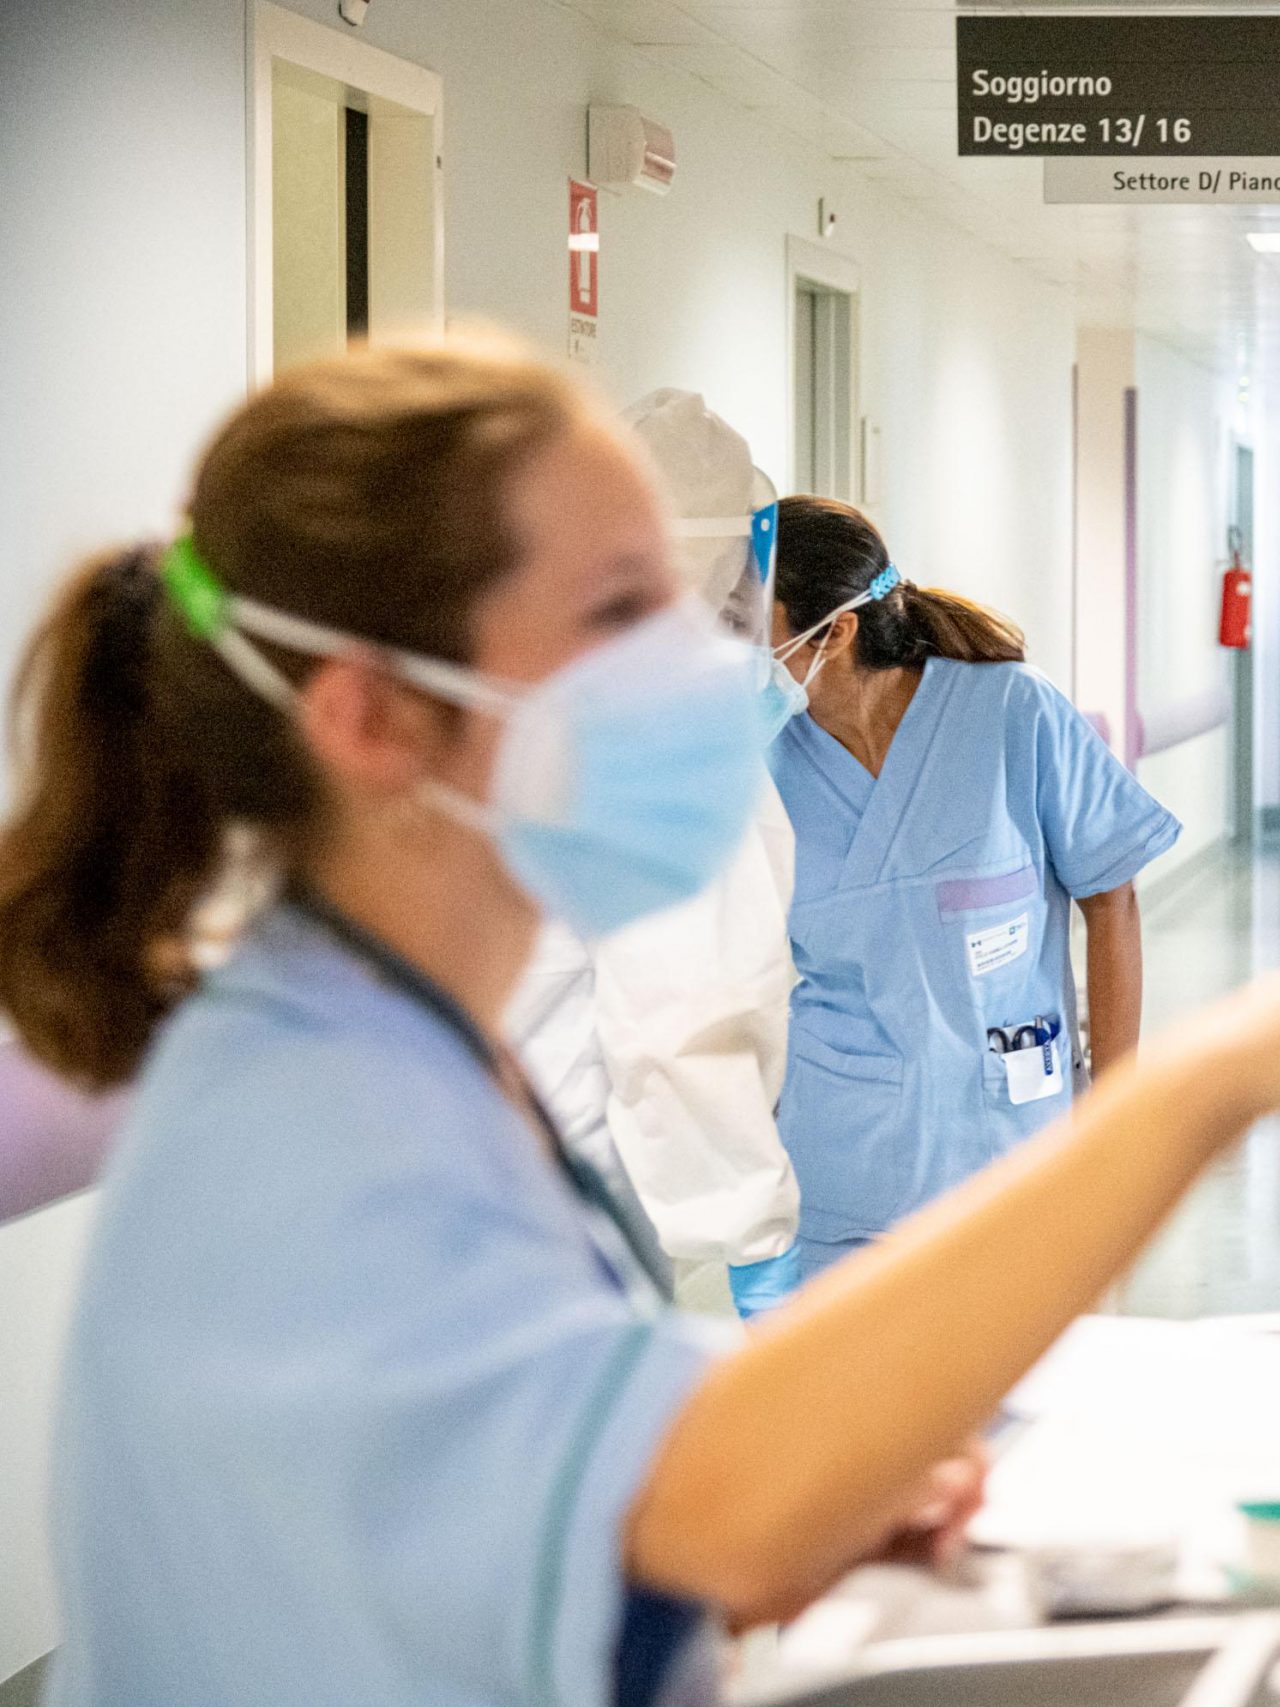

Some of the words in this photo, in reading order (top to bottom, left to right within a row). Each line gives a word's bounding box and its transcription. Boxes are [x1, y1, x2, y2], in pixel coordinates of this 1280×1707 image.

[972, 70, 1112, 103] Soggiorno
[973, 117, 1087, 150] Degenze
[1099, 115, 1146, 147] 13/
[1156, 118, 1192, 144] 16
[1113, 171, 1190, 192] Settore
[1199, 171, 1222, 194] D/
